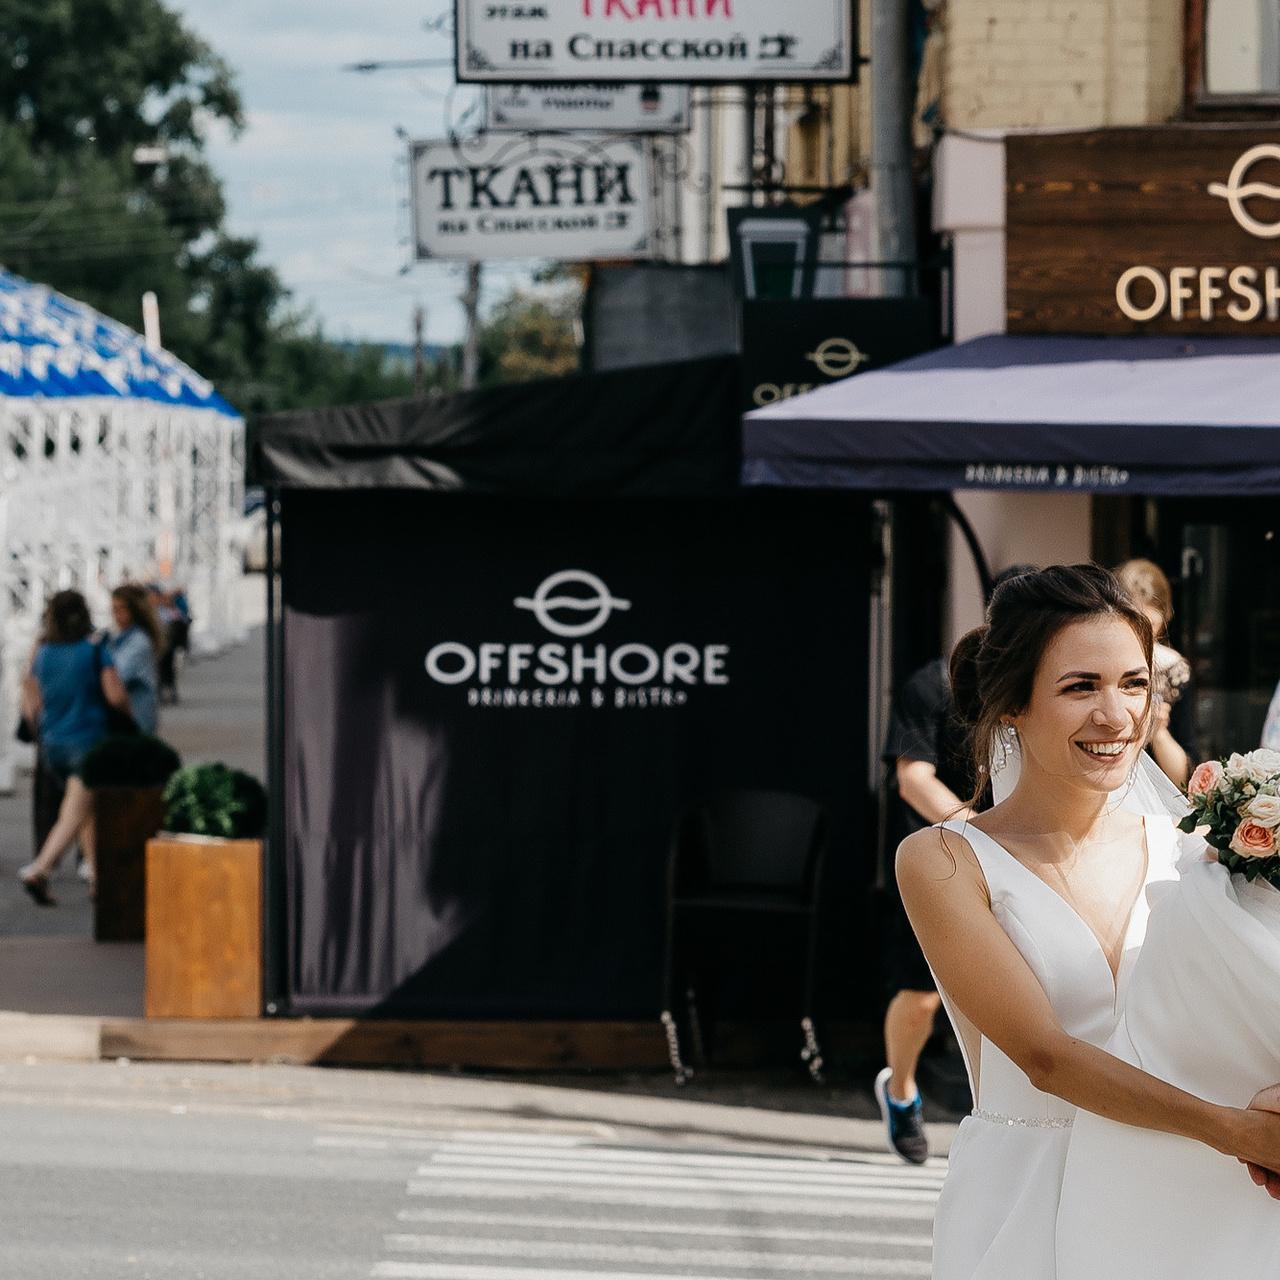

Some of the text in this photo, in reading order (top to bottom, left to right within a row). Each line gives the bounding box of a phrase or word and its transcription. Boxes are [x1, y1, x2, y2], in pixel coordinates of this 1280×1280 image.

[509, 32, 749, 61] на Спасской
[427, 162, 635, 209] ТКАНИ
[424, 641, 731, 686] OFFSHORE
